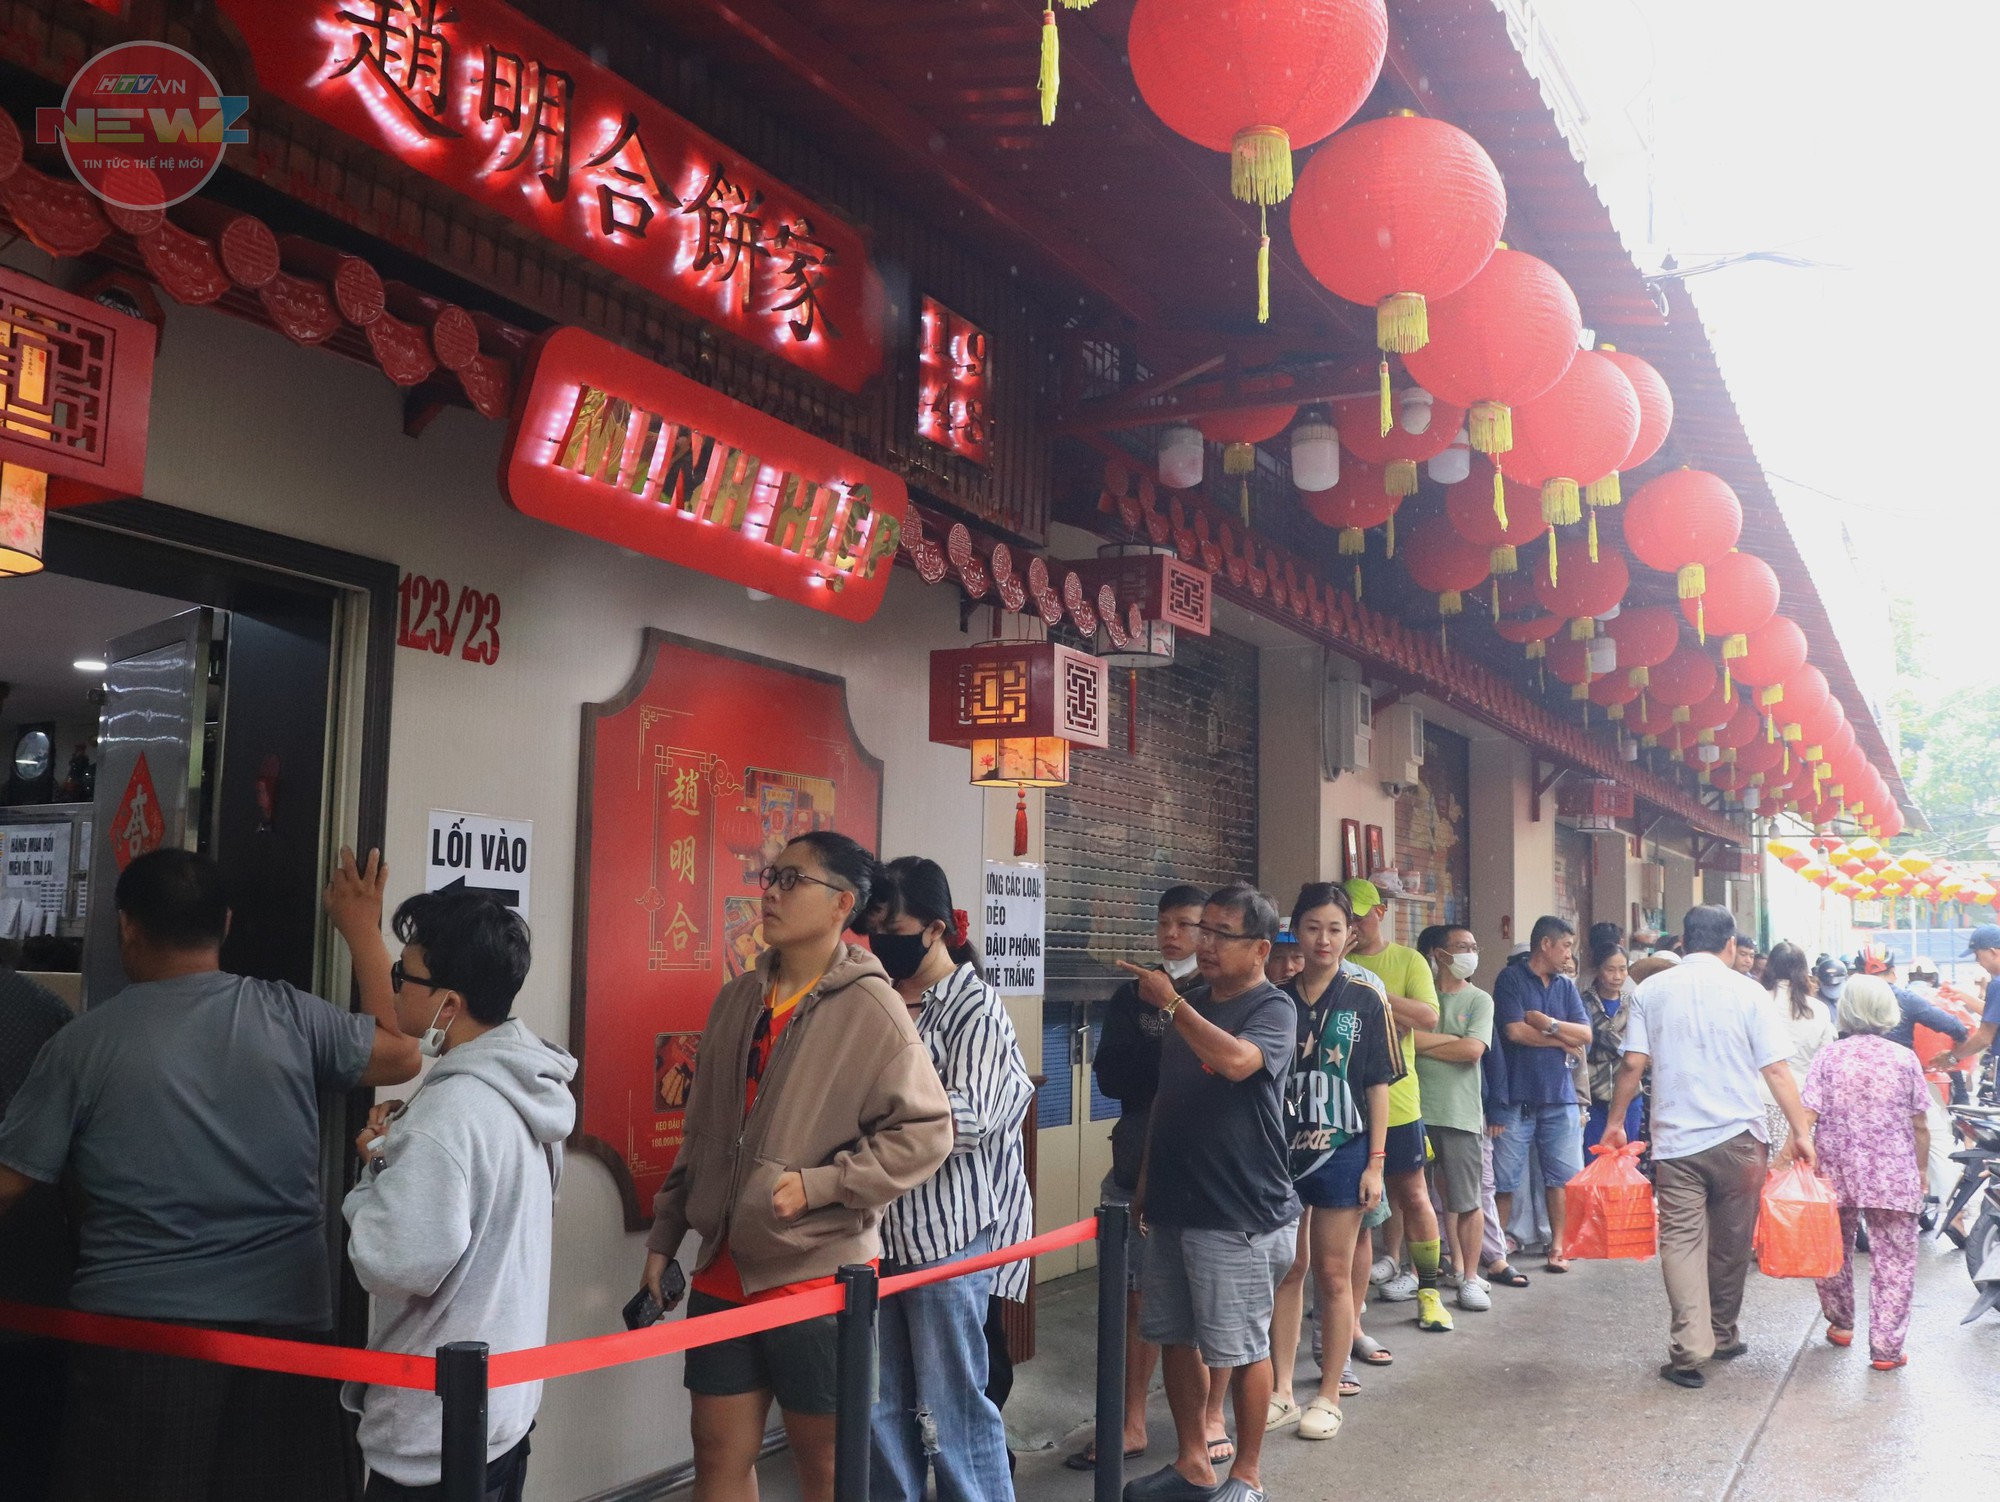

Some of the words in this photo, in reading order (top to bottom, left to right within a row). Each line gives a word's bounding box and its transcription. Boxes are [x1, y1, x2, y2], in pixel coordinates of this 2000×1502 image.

[328, 0, 842, 342] 趙明合餅家
[553, 384, 762, 533] MINH
[396, 572, 501, 666] 123/23
[431, 817, 473, 869] LỐI
[480, 827, 527, 874] VÀO
[664, 767, 701, 951] 趙明合
[986, 899, 1006, 926] DẺO
[1005, 871, 1021, 897] CÁC
[1022, 876, 1042, 902] LOẠI:
[985, 932, 1006, 961] ĐẬU
[1009, 933, 1041, 961] PHỘNG
[1004, 960, 1035, 987] TRẮNG
